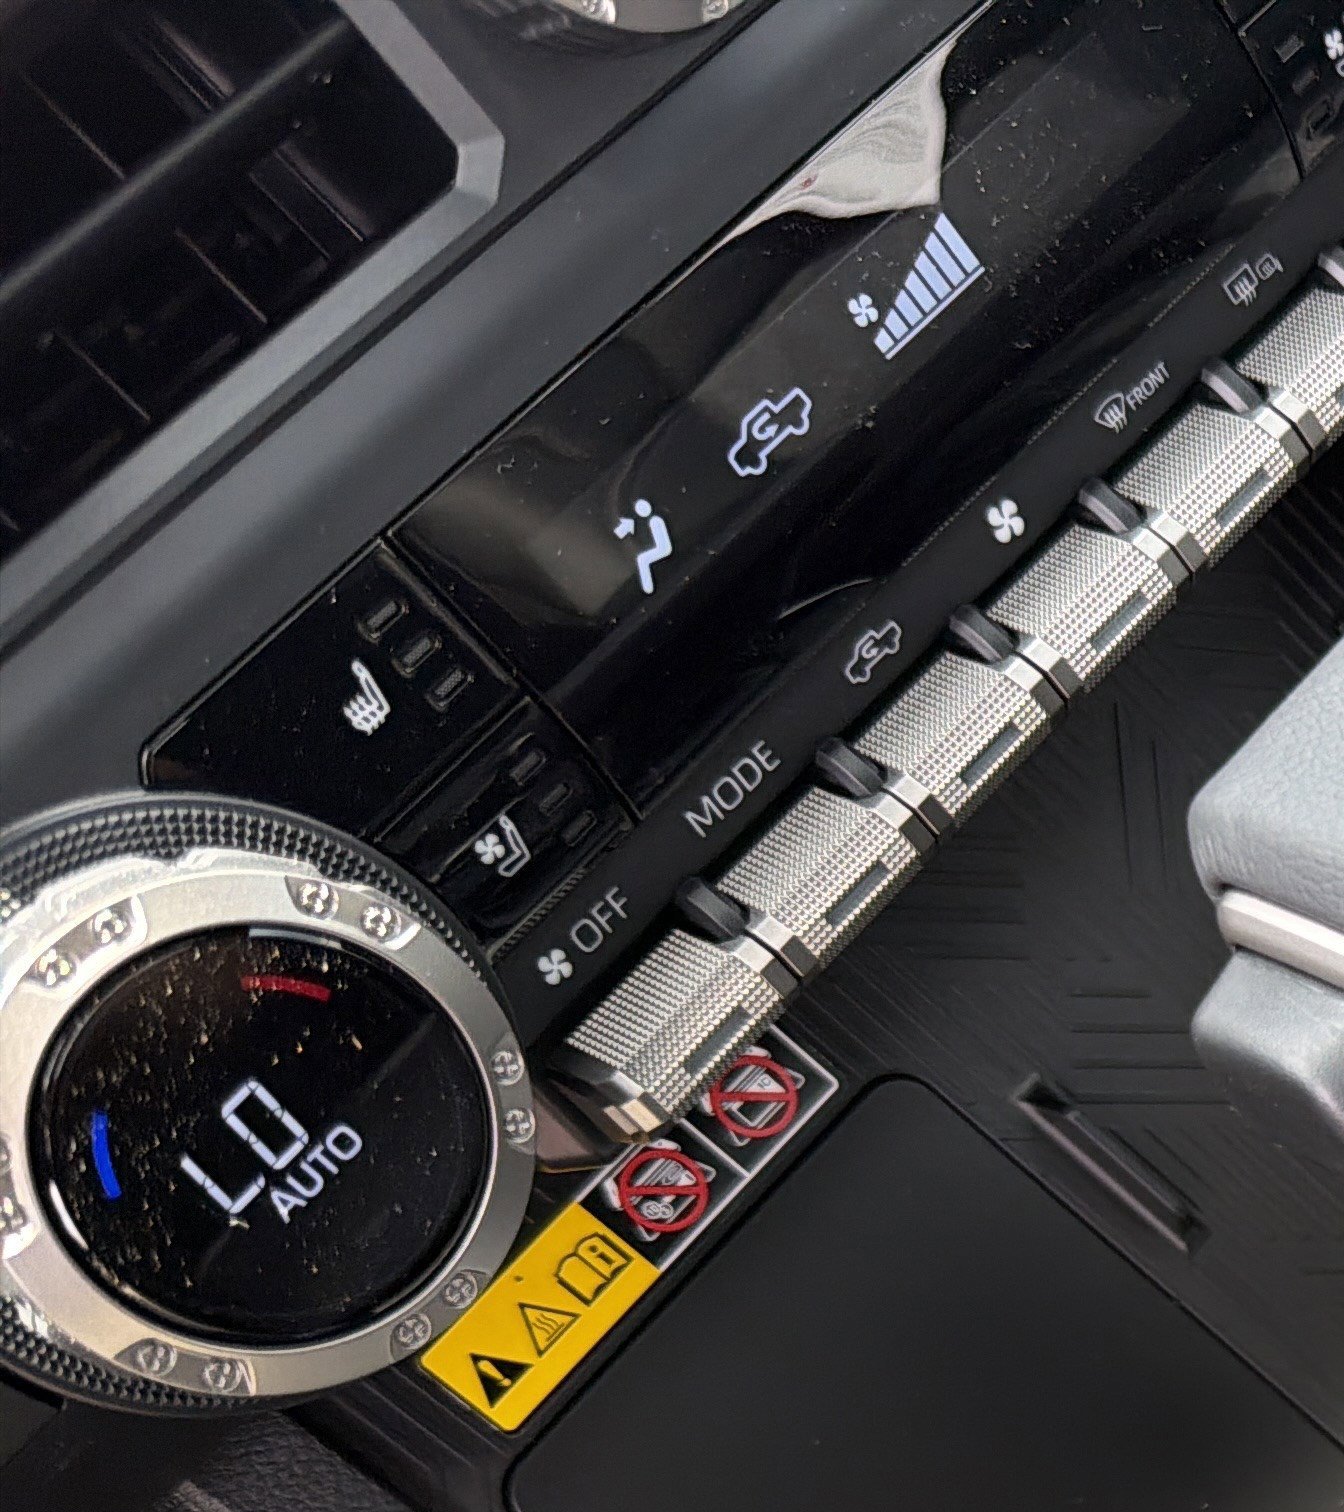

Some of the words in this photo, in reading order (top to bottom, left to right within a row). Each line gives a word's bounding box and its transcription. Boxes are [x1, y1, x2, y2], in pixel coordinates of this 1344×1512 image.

[1125, 361, 1170, 411] FRONT
[685, 740, 781, 838] MODE
[570, 886, 628, 953] OFF
[270, 1124, 363, 1224] AUTO
